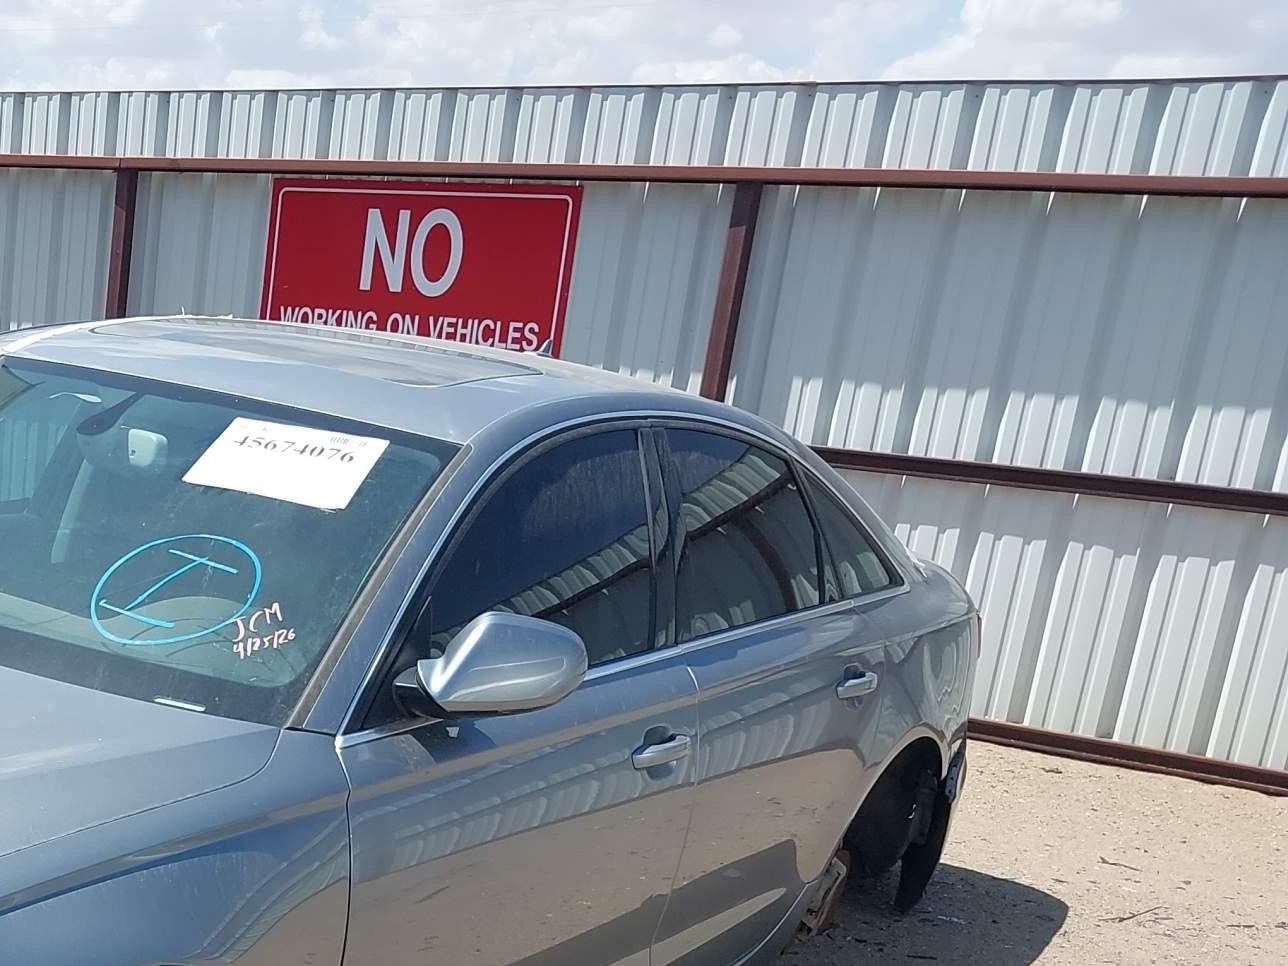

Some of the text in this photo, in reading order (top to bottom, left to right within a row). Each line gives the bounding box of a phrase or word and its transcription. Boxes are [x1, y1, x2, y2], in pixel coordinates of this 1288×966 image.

[359, 207, 463, 297] NO
[280, 305, 539, 350] WORKING ON VEHICLES
[233, 435, 355, 463] 45674076
